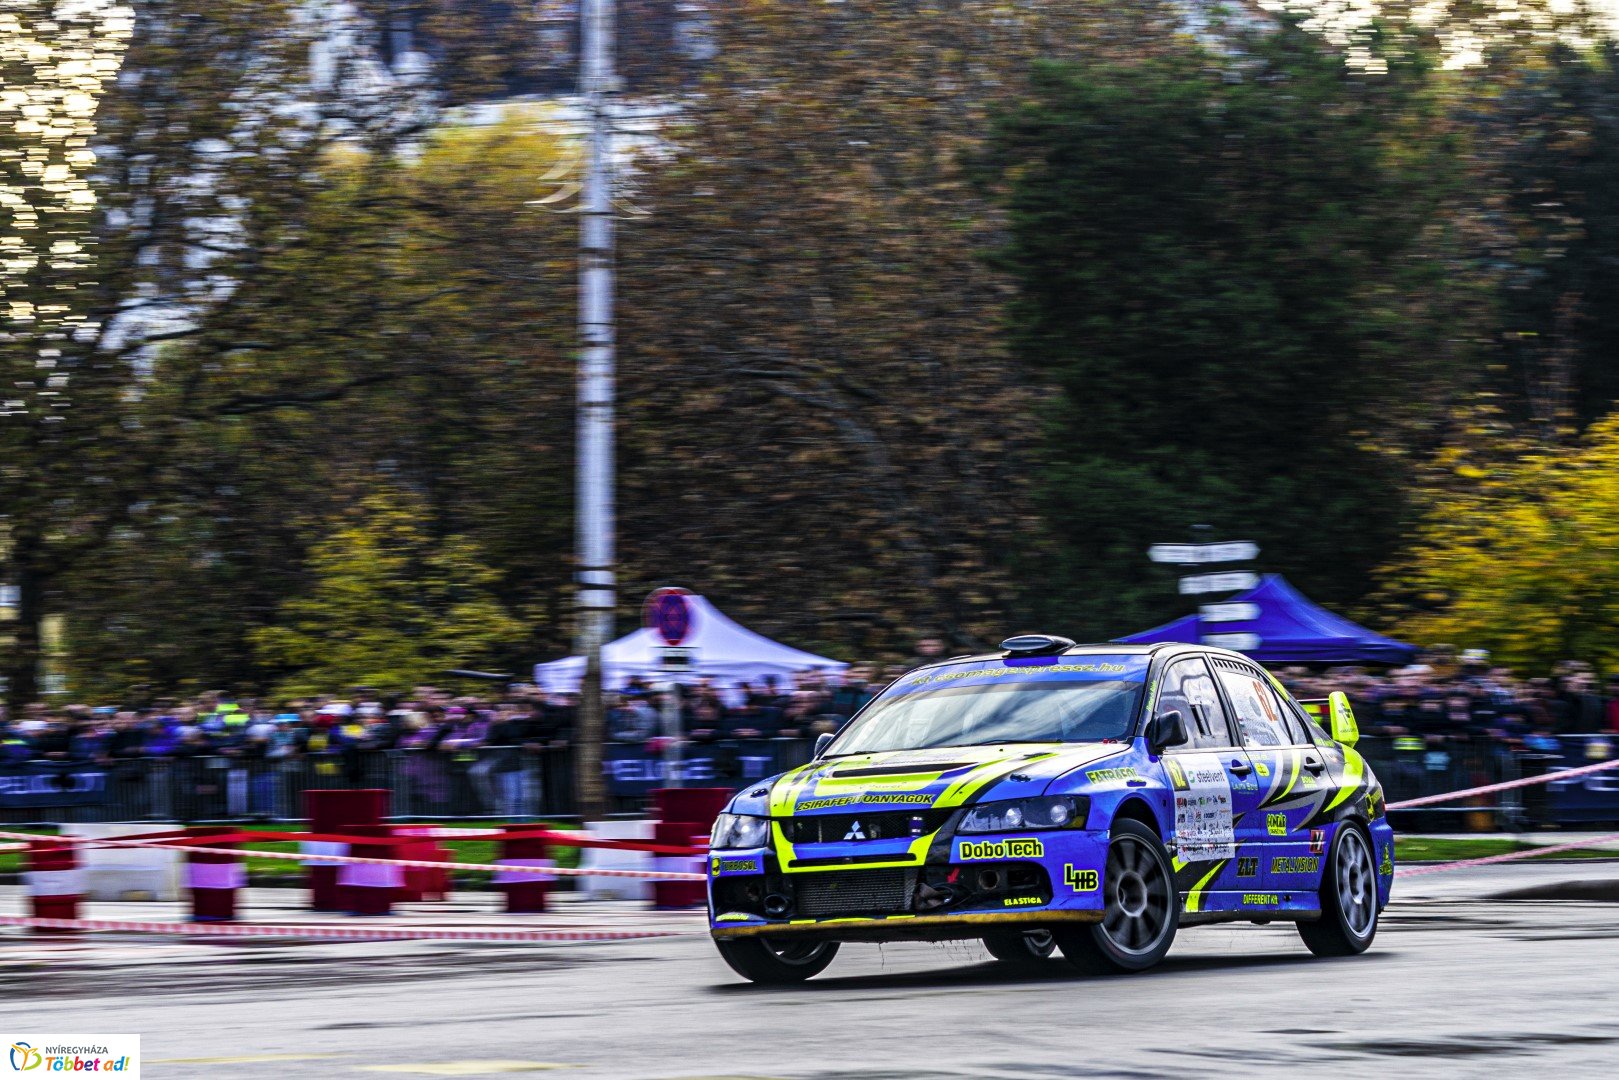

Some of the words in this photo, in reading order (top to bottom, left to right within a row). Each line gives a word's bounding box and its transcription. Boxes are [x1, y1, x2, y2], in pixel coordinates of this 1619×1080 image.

[1167, 760, 1187, 787] 62
[1196, 770, 1226, 783] steelvent
[961, 838, 1044, 860] DoboTech
[1065, 864, 1098, 890] LHB
[1004, 897, 1042, 906] ELASTICA
